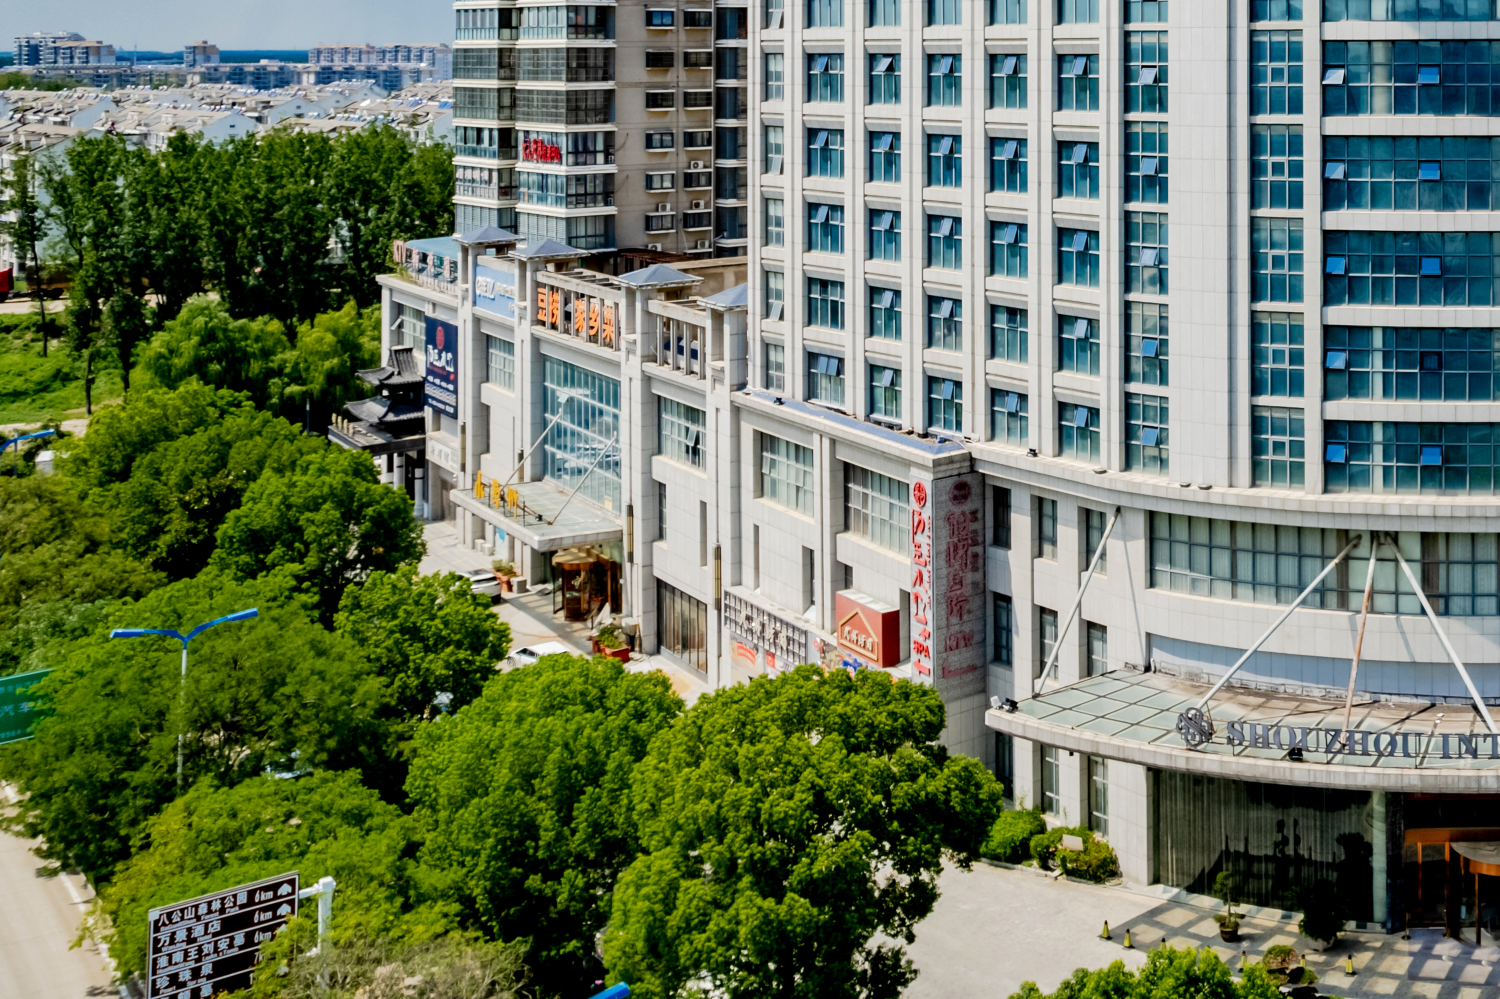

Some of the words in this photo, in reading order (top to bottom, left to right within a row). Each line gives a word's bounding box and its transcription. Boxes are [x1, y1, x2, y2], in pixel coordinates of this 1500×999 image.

[912, 639, 931, 660] SPA
[1226, 720, 1425, 759] SHOUZHOU
[158, 891, 248, 927] 八公山森林公园
[157, 919, 221, 948] 万景酒店
[156, 932, 246, 969] 淮南王刘安墓
[155, 962, 213, 990] 珍珠泉
